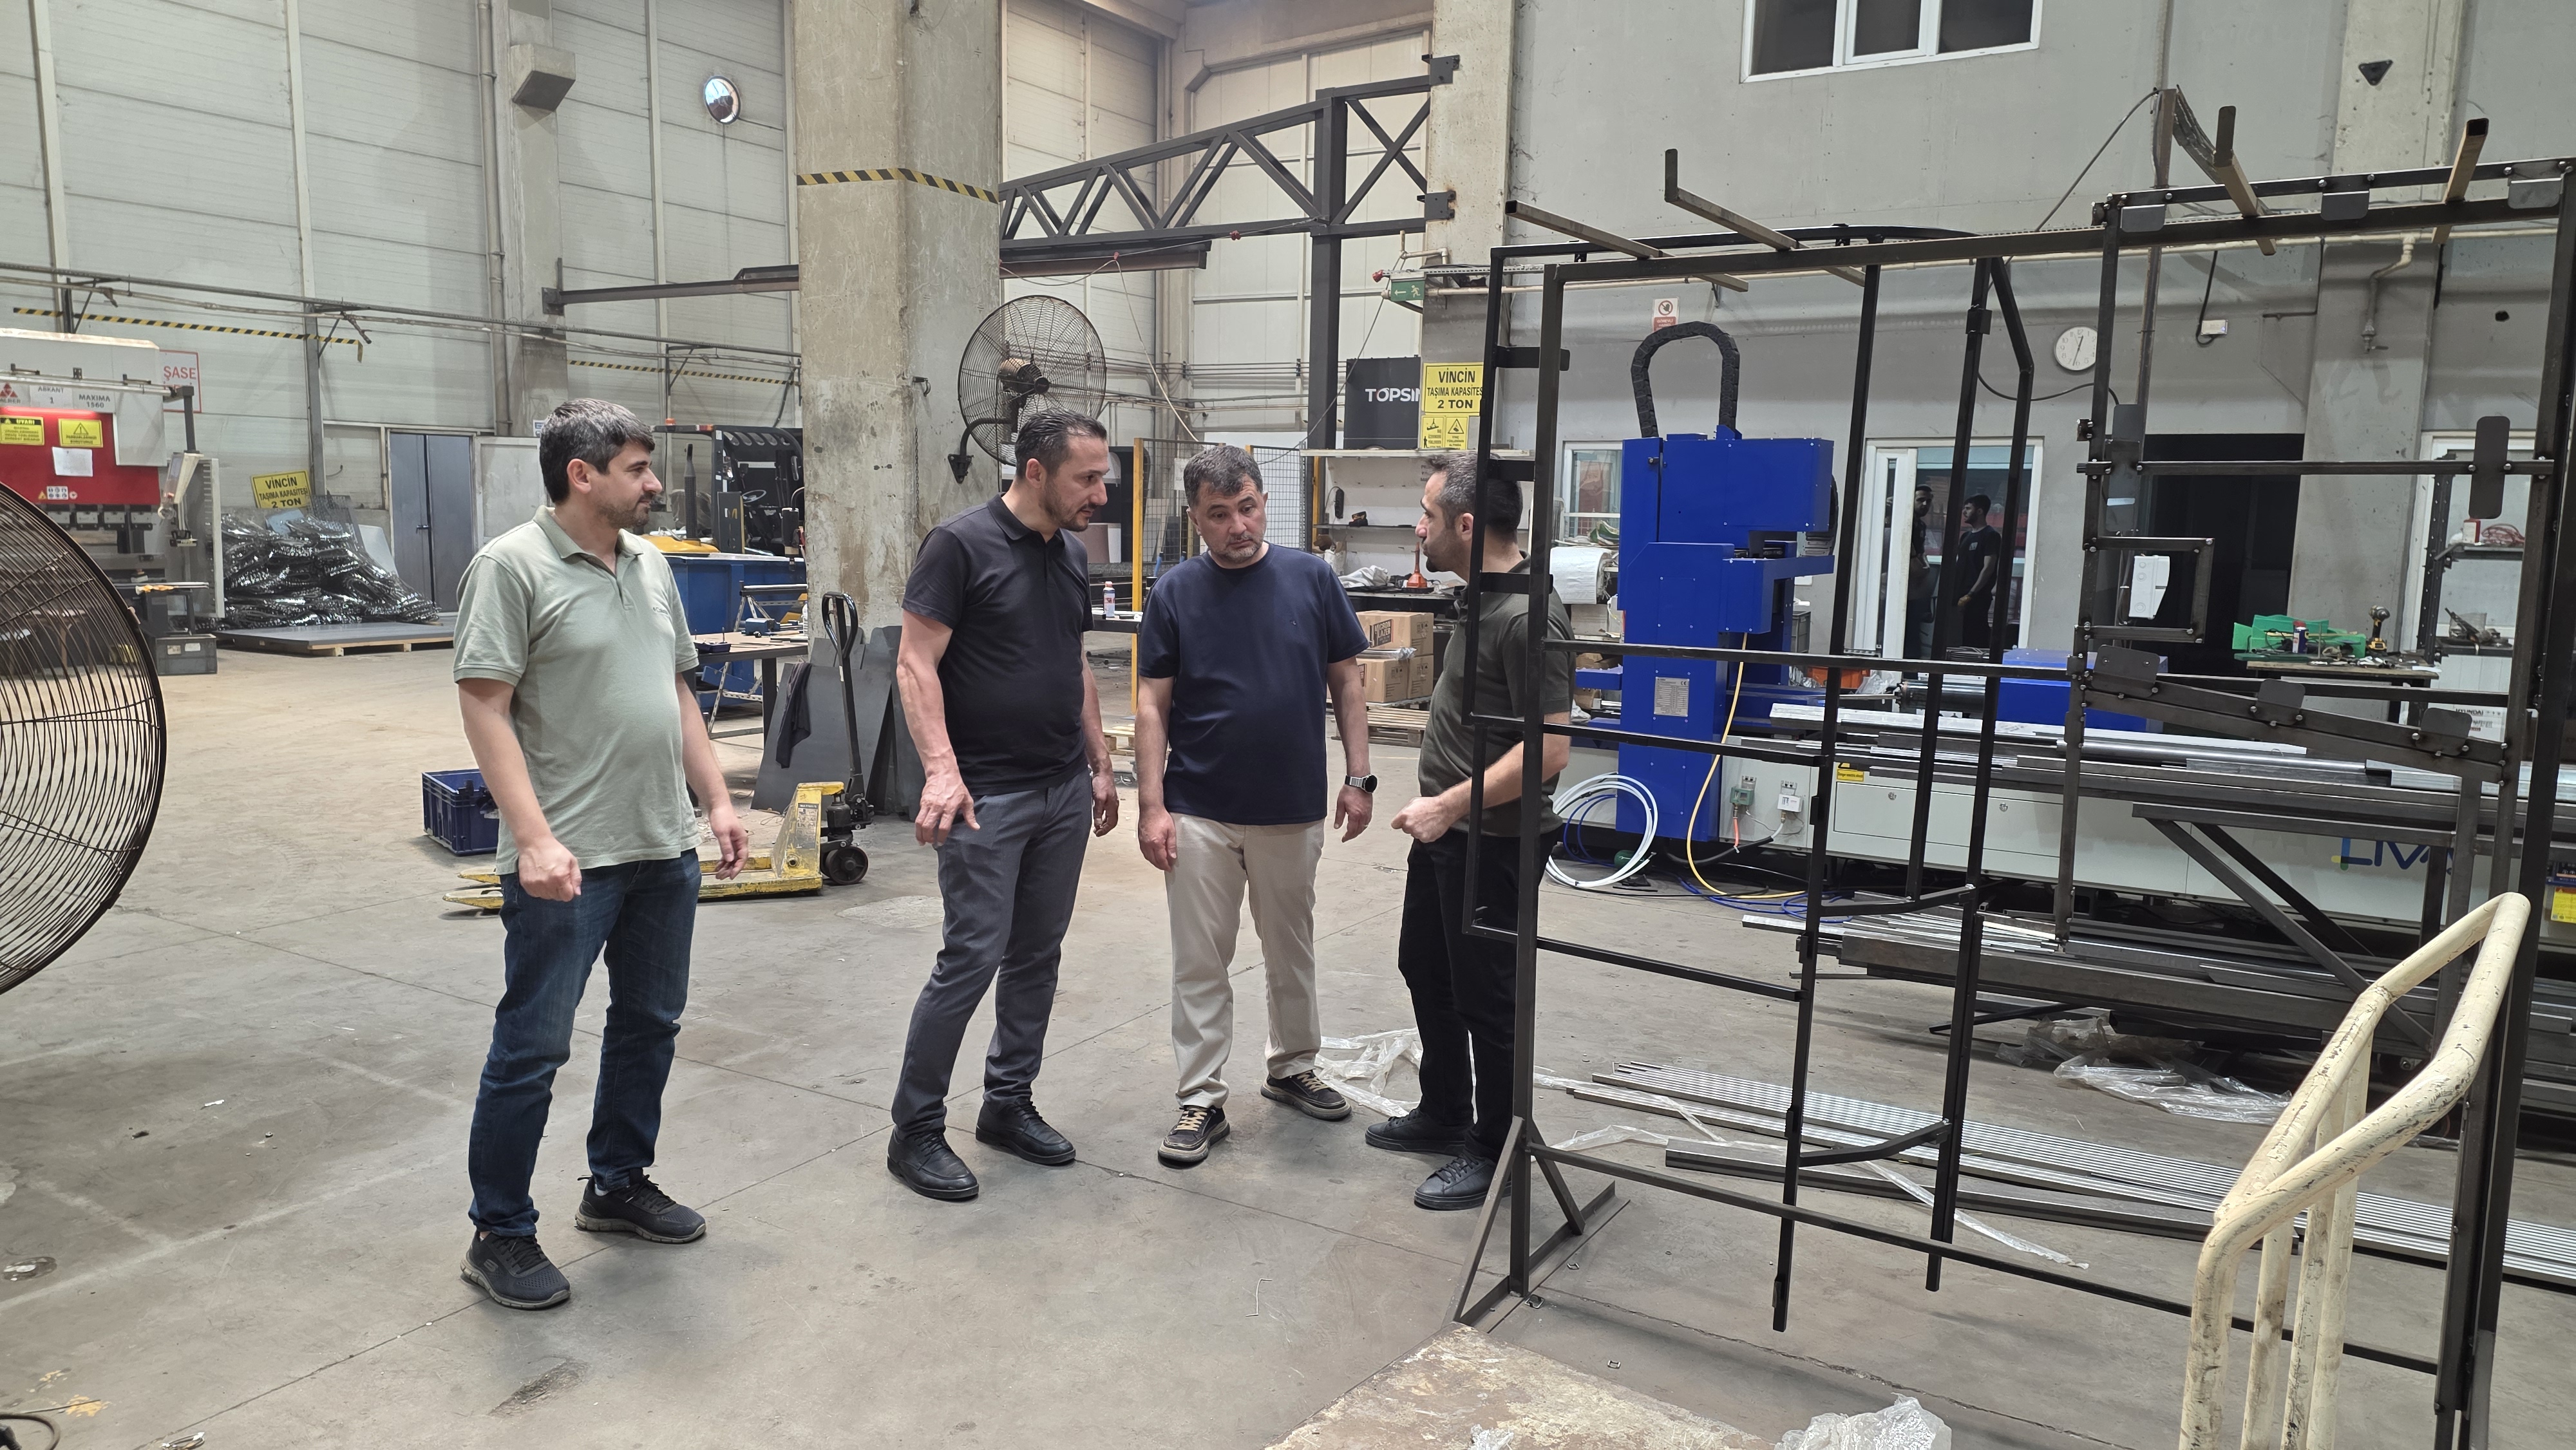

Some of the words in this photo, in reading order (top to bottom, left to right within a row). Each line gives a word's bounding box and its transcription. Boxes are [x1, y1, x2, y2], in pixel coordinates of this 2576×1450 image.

[164, 366, 196, 381] ŞASE
[1438, 368, 1475, 383] VİNCİN
[79, 393, 111, 402] MAXIMA
[1427, 388, 1449, 399] TAŞIMA
[1451, 384, 1482, 397] KAPASİTES
[1437, 399, 1444, 409] 2
[1448, 400, 1473, 409] TON
[265, 475, 298, 489] VİNCİN
[259, 491, 279, 502] TAŞIMA
[279, 497, 301, 507] TON
